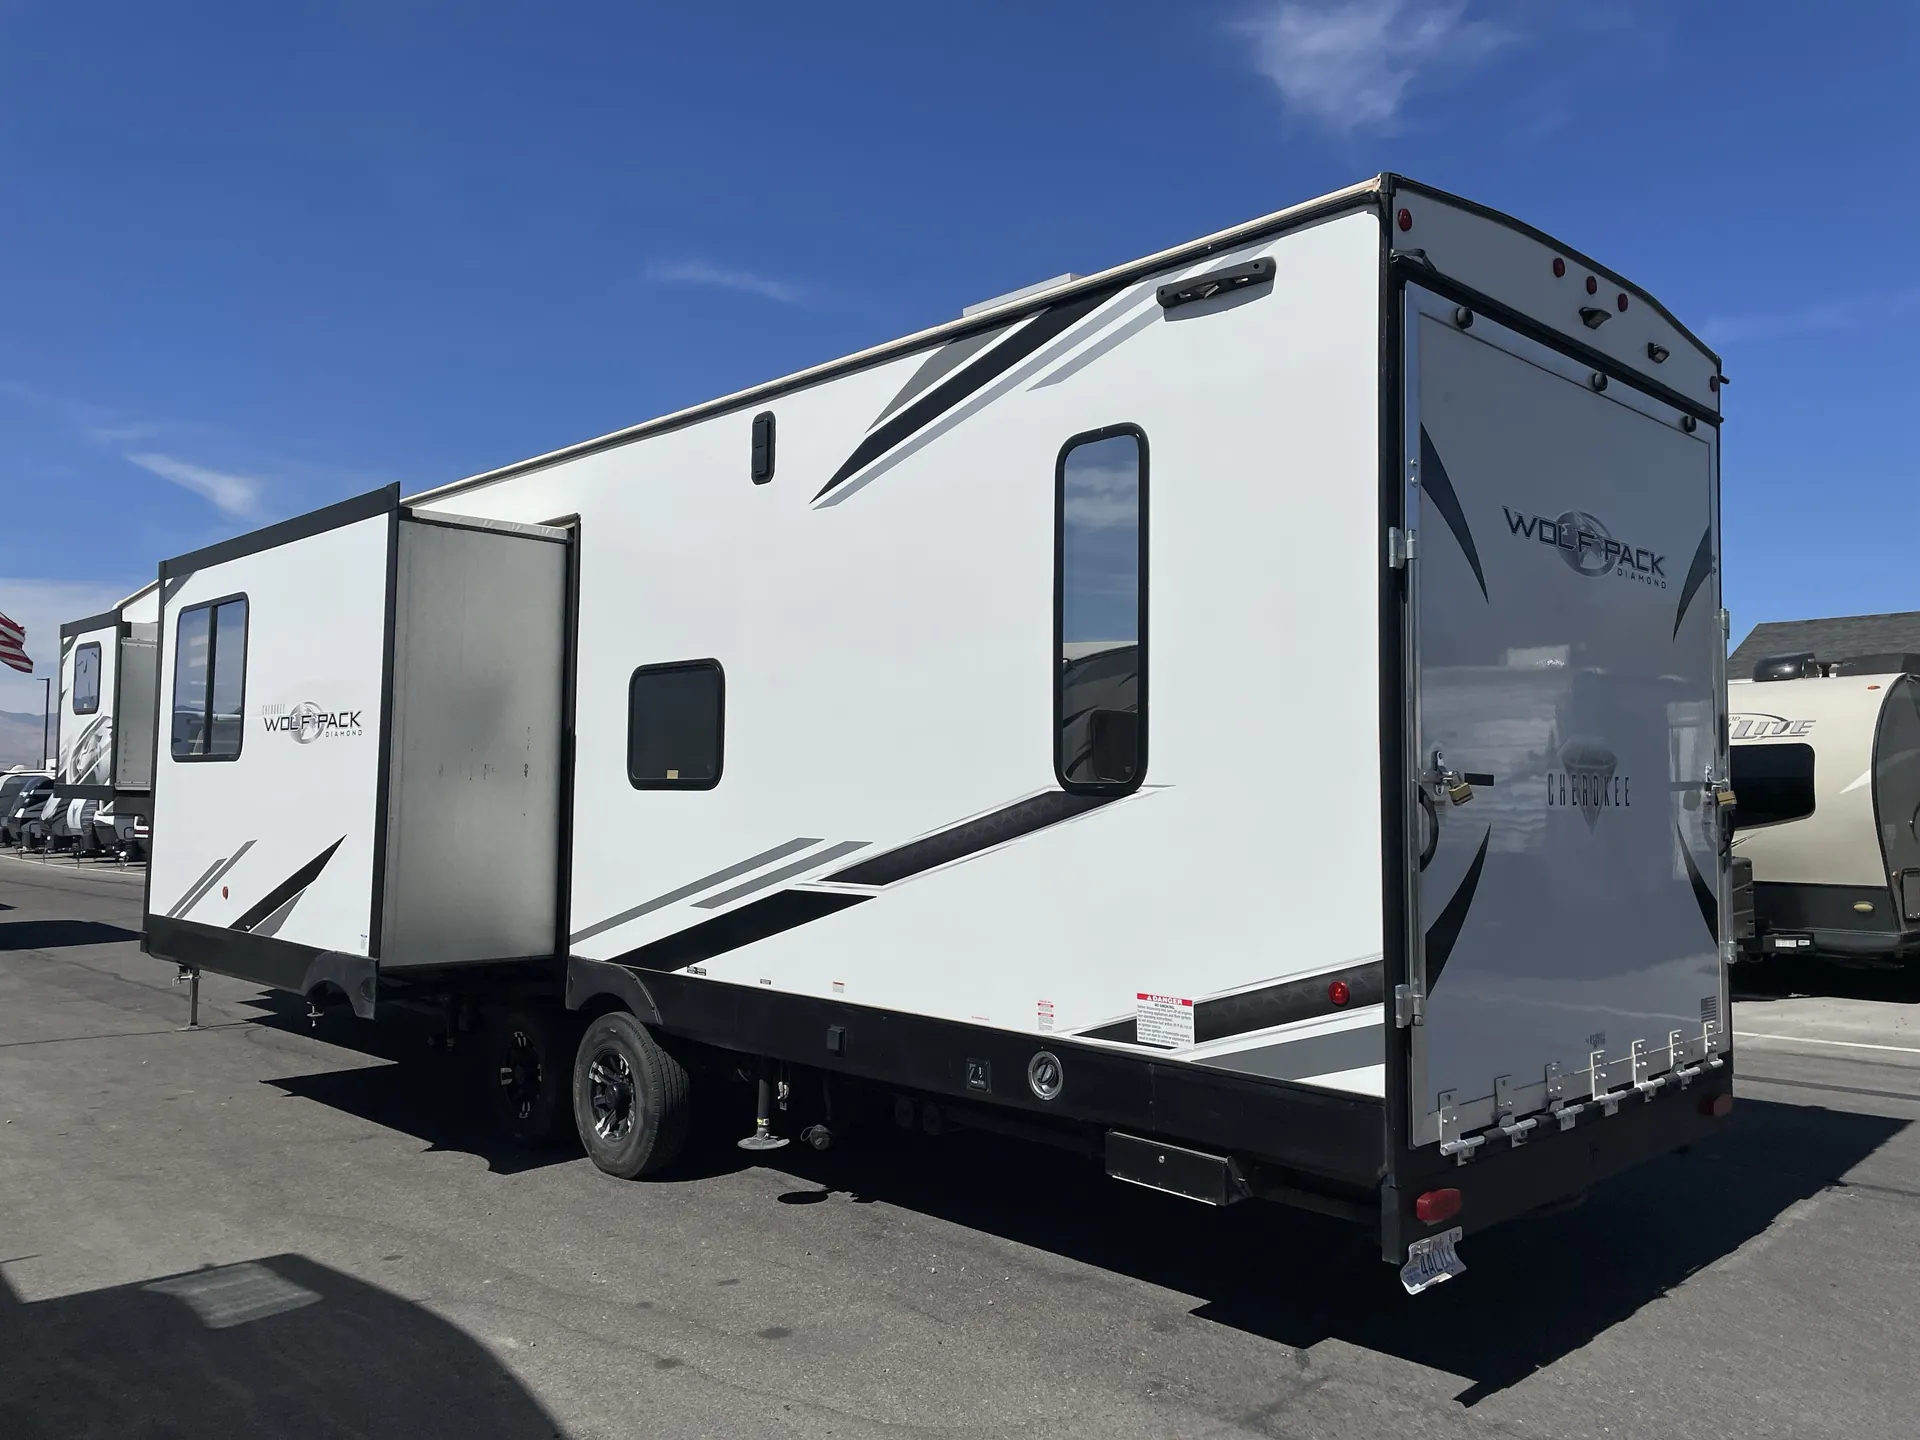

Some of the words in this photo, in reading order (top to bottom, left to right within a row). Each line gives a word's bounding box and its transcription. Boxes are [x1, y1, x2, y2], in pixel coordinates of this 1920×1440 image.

[1502, 504, 1596, 553] WOLF
[1602, 537, 1668, 578] PACK
[1617, 567, 1668, 590] DIAMOND
[264, 715, 311, 732] WOLF
[317, 710, 362, 729] PACK
[325, 729, 363, 738] DIAMOND
[1547, 772, 1631, 807] CHEROKEE
[1152, 996, 1182, 1005] DANGER
